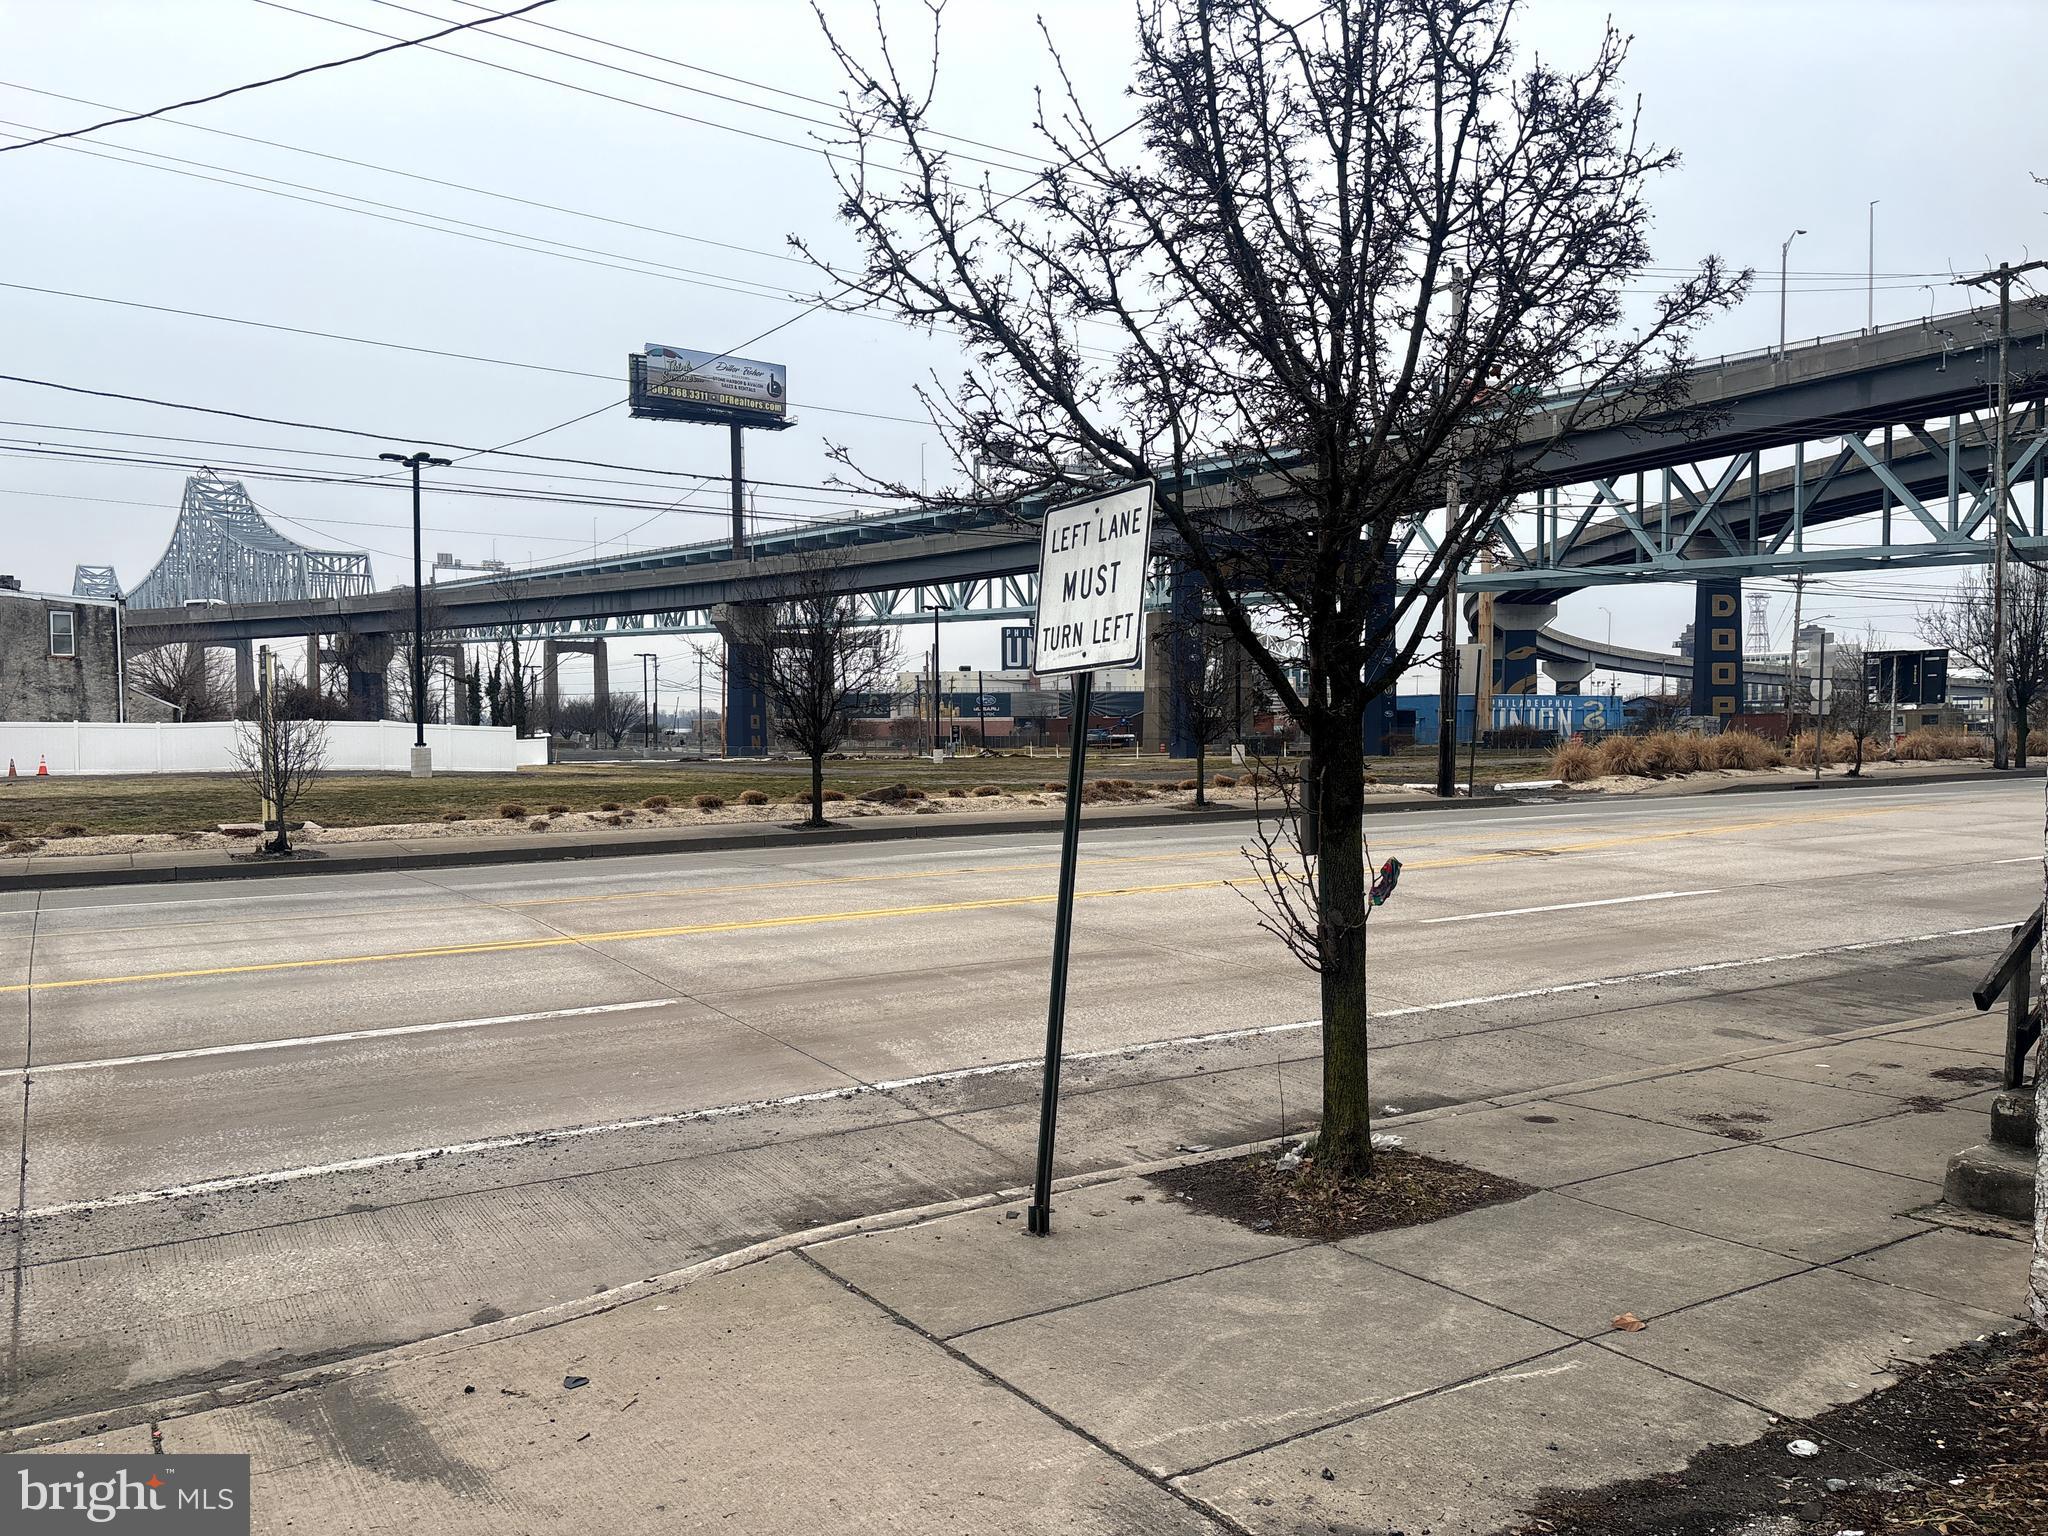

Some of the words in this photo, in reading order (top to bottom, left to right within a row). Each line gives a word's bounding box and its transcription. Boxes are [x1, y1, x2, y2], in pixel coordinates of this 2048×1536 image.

[1051, 521, 1091, 554] LEFT
[1098, 507, 1142, 543] LANE
[1062, 560, 1121, 602] MUST
[1043, 622, 1084, 652] TURN
[1092, 612, 1134, 645] LEFT
